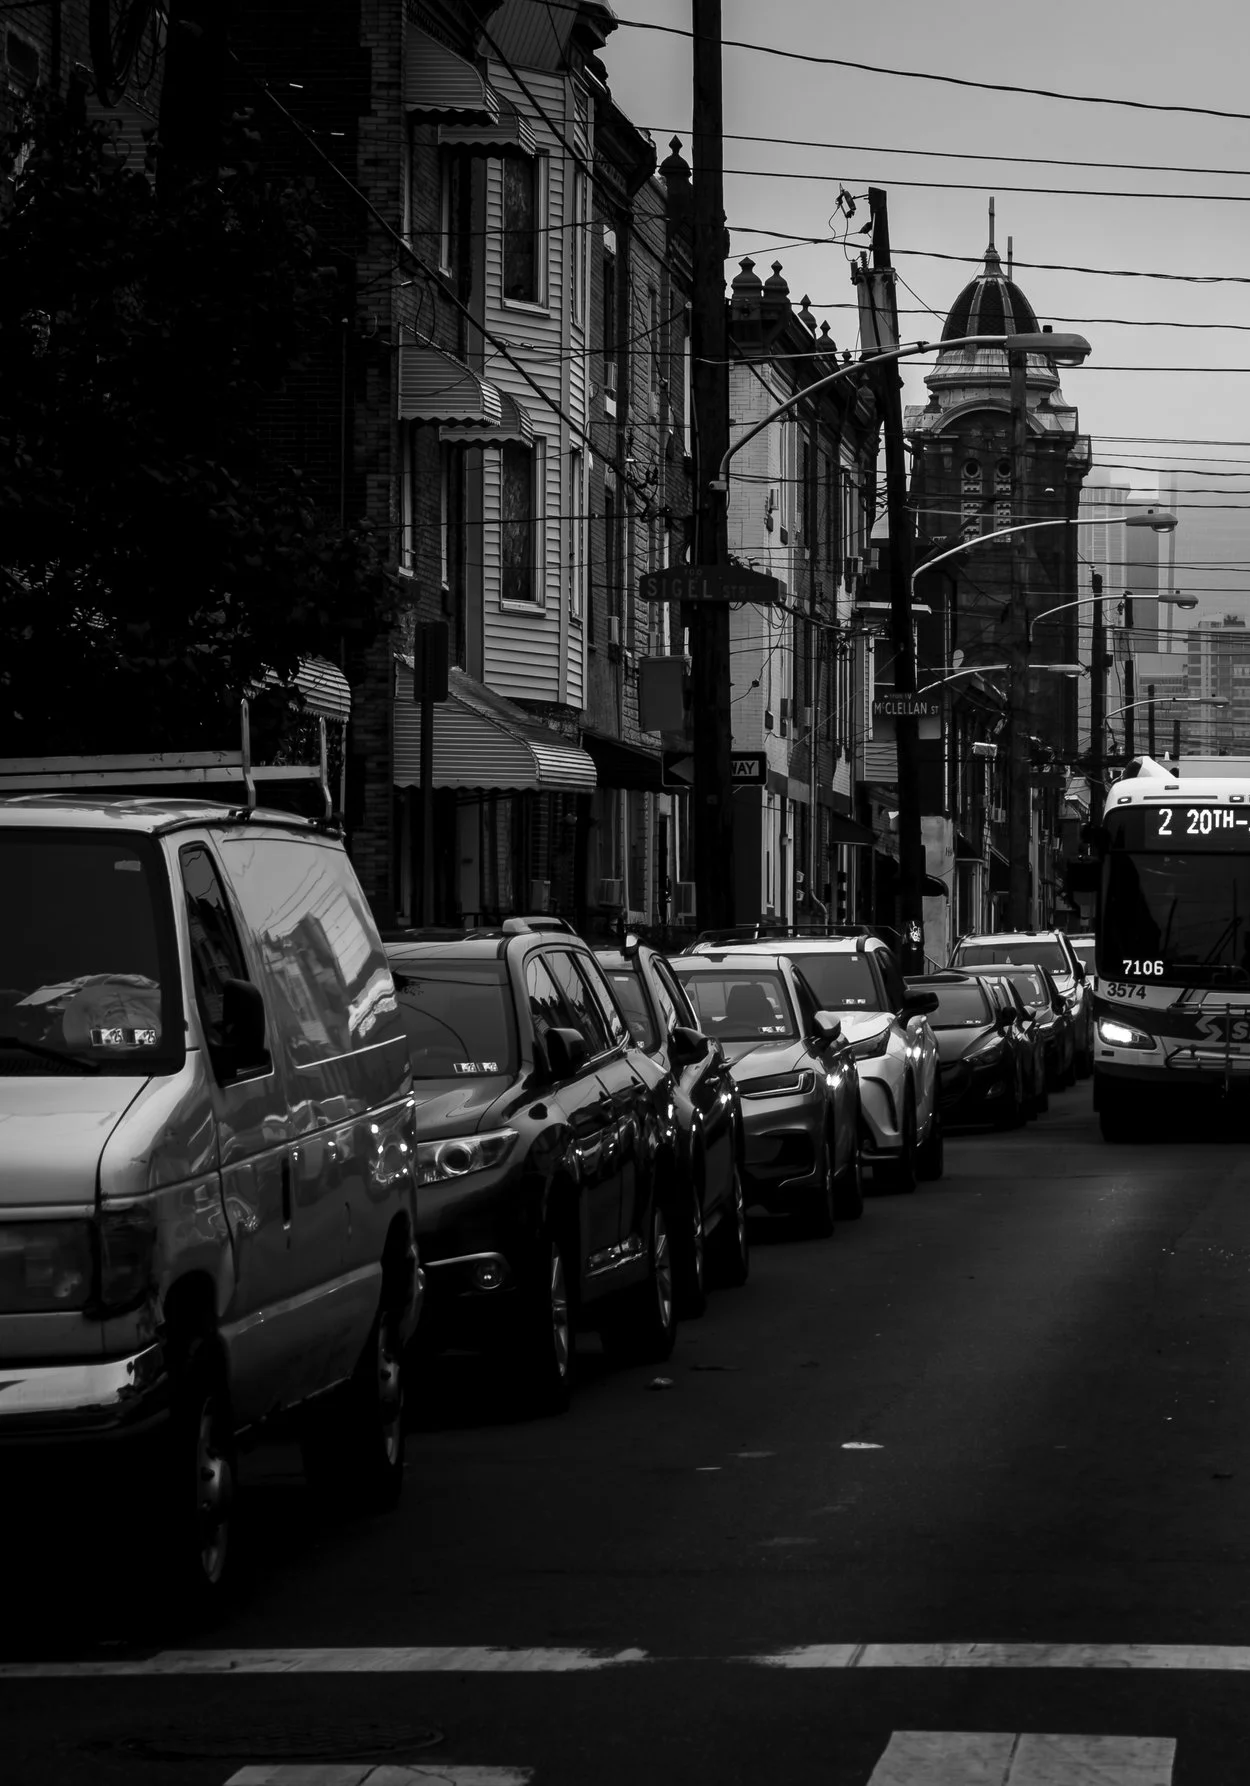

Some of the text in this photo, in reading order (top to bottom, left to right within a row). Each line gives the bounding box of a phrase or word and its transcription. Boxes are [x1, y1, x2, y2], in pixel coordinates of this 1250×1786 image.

[646, 577, 713, 599] SIGEL
[930, 705, 939, 715] ST
[1158, 808, 1173, 836] 2
[1122, 959, 1164, 976] 7106
[1107, 982, 1147, 1000] 3574
